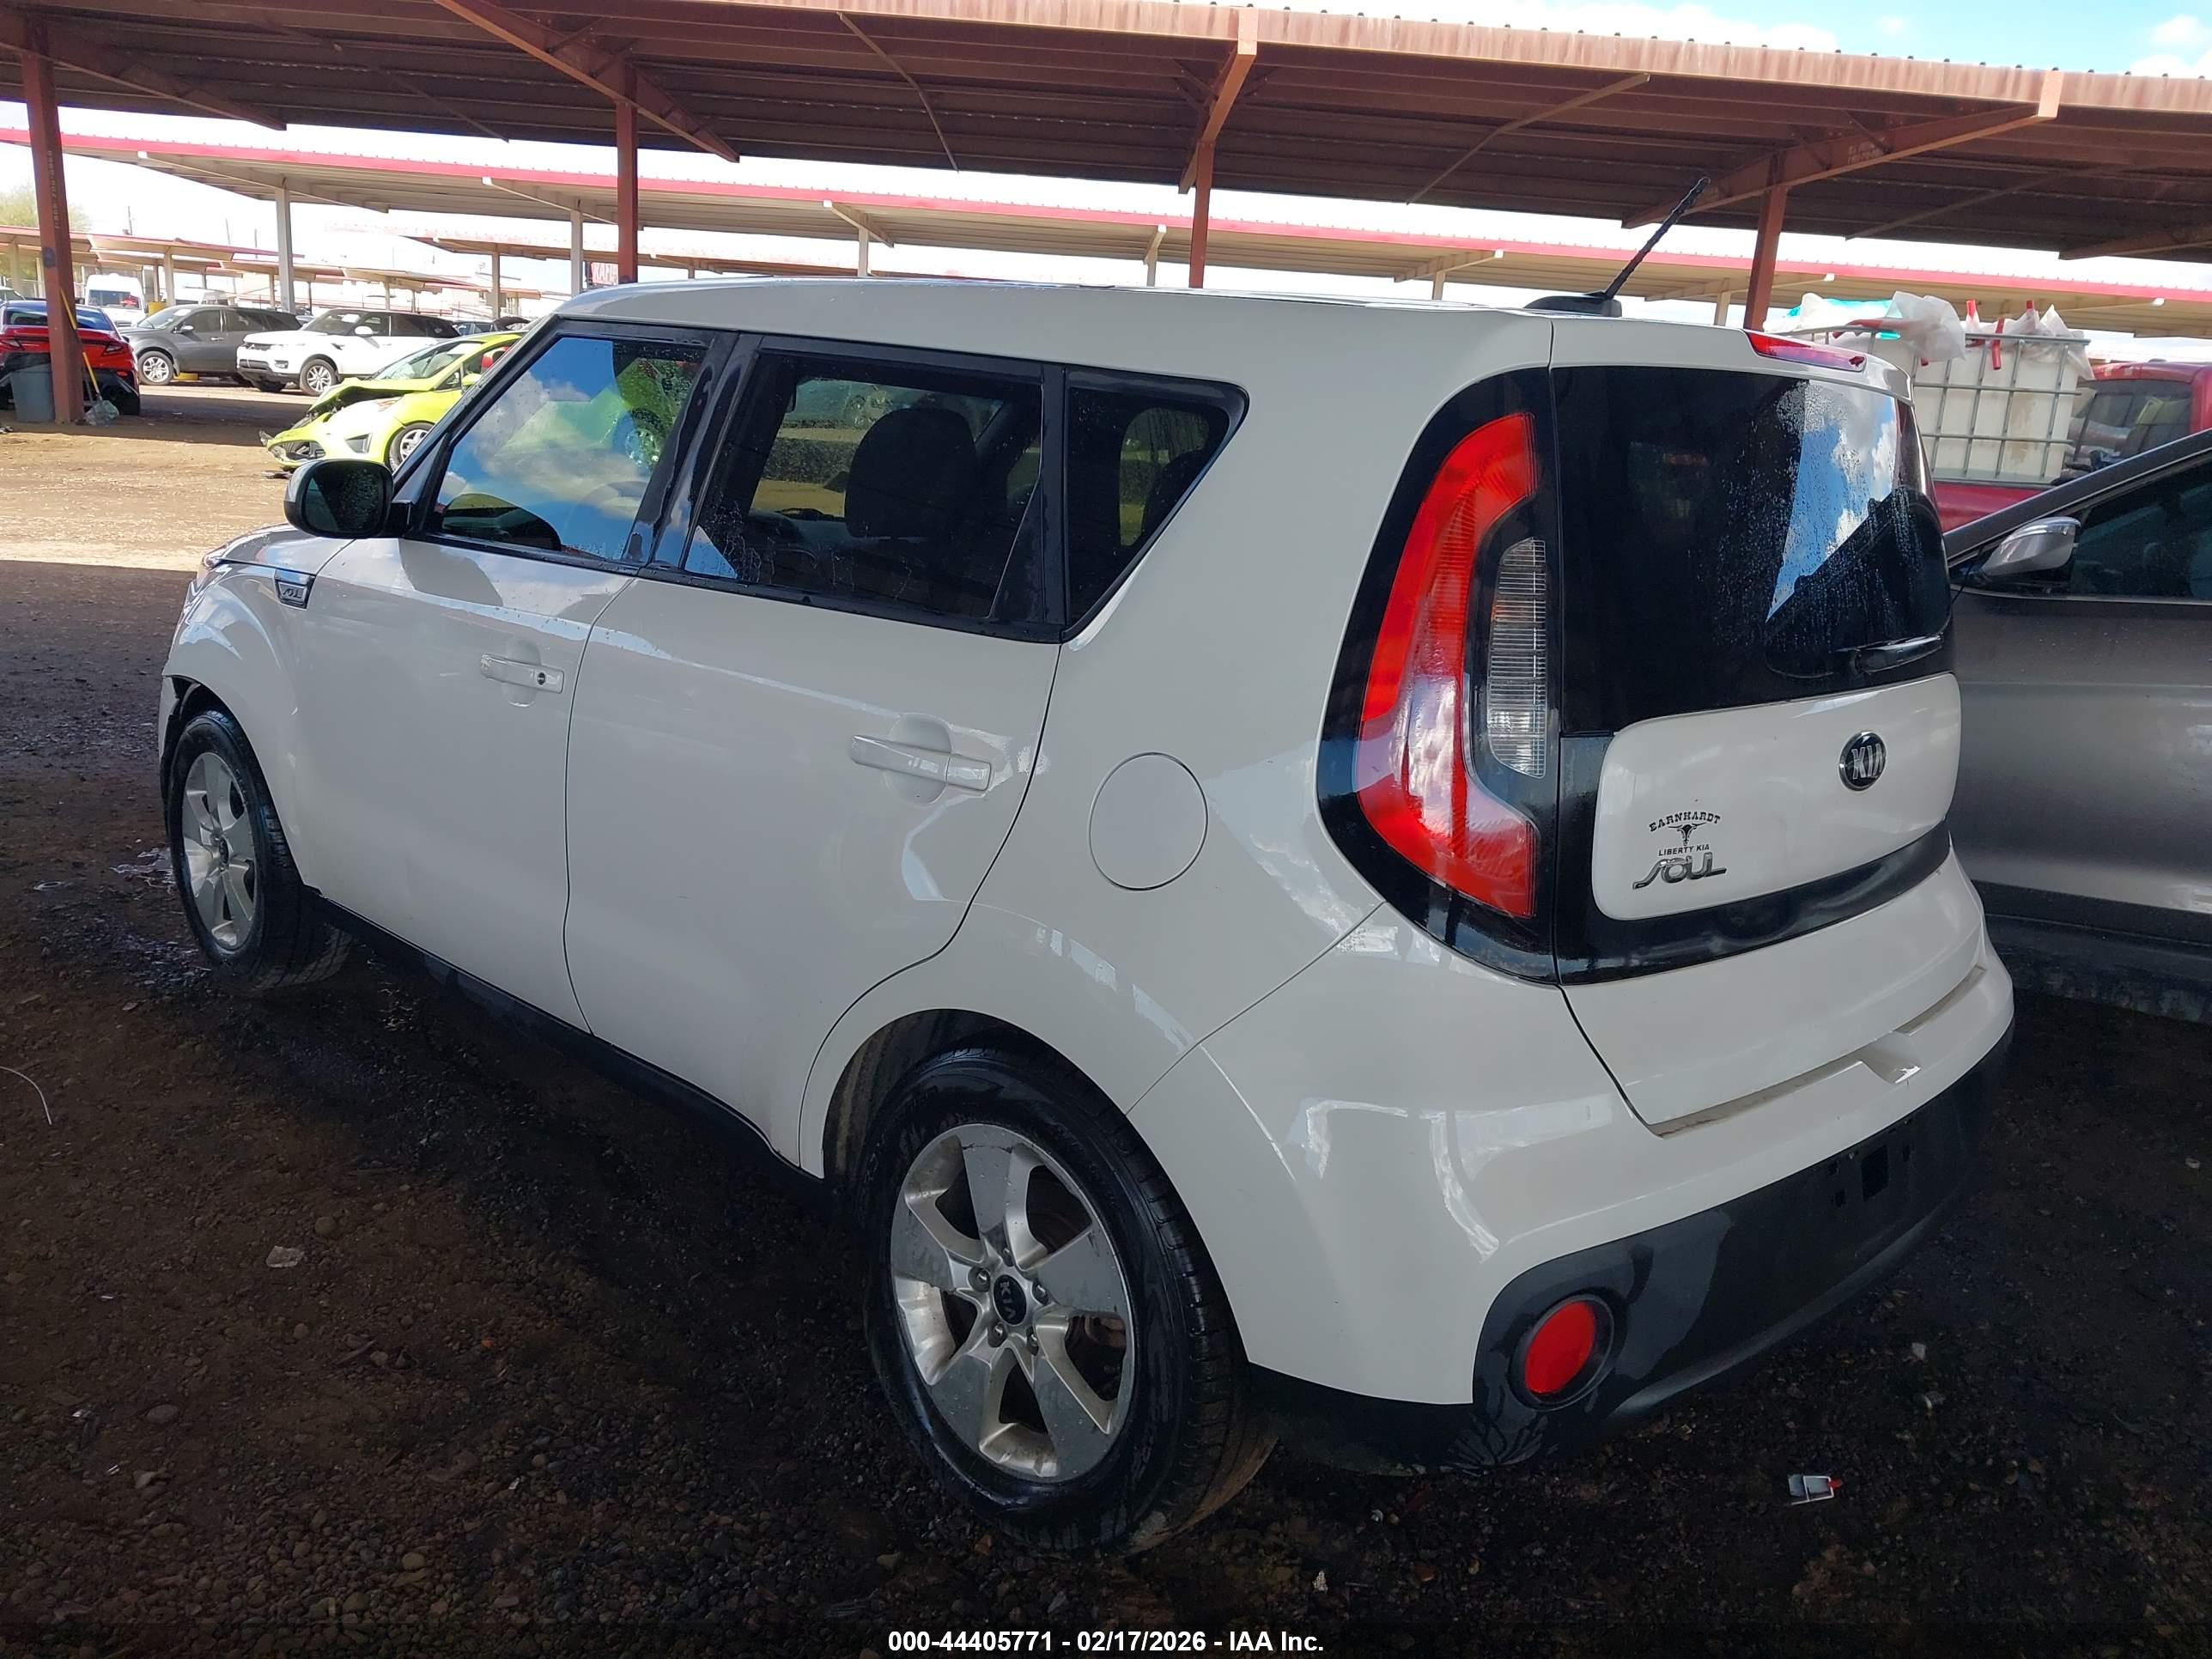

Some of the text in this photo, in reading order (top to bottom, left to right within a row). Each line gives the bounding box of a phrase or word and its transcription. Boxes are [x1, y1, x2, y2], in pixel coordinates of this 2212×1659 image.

[1649, 811, 1721, 832] EARNHARDT
[1658, 843, 1710, 856] LIBERTY KIA
